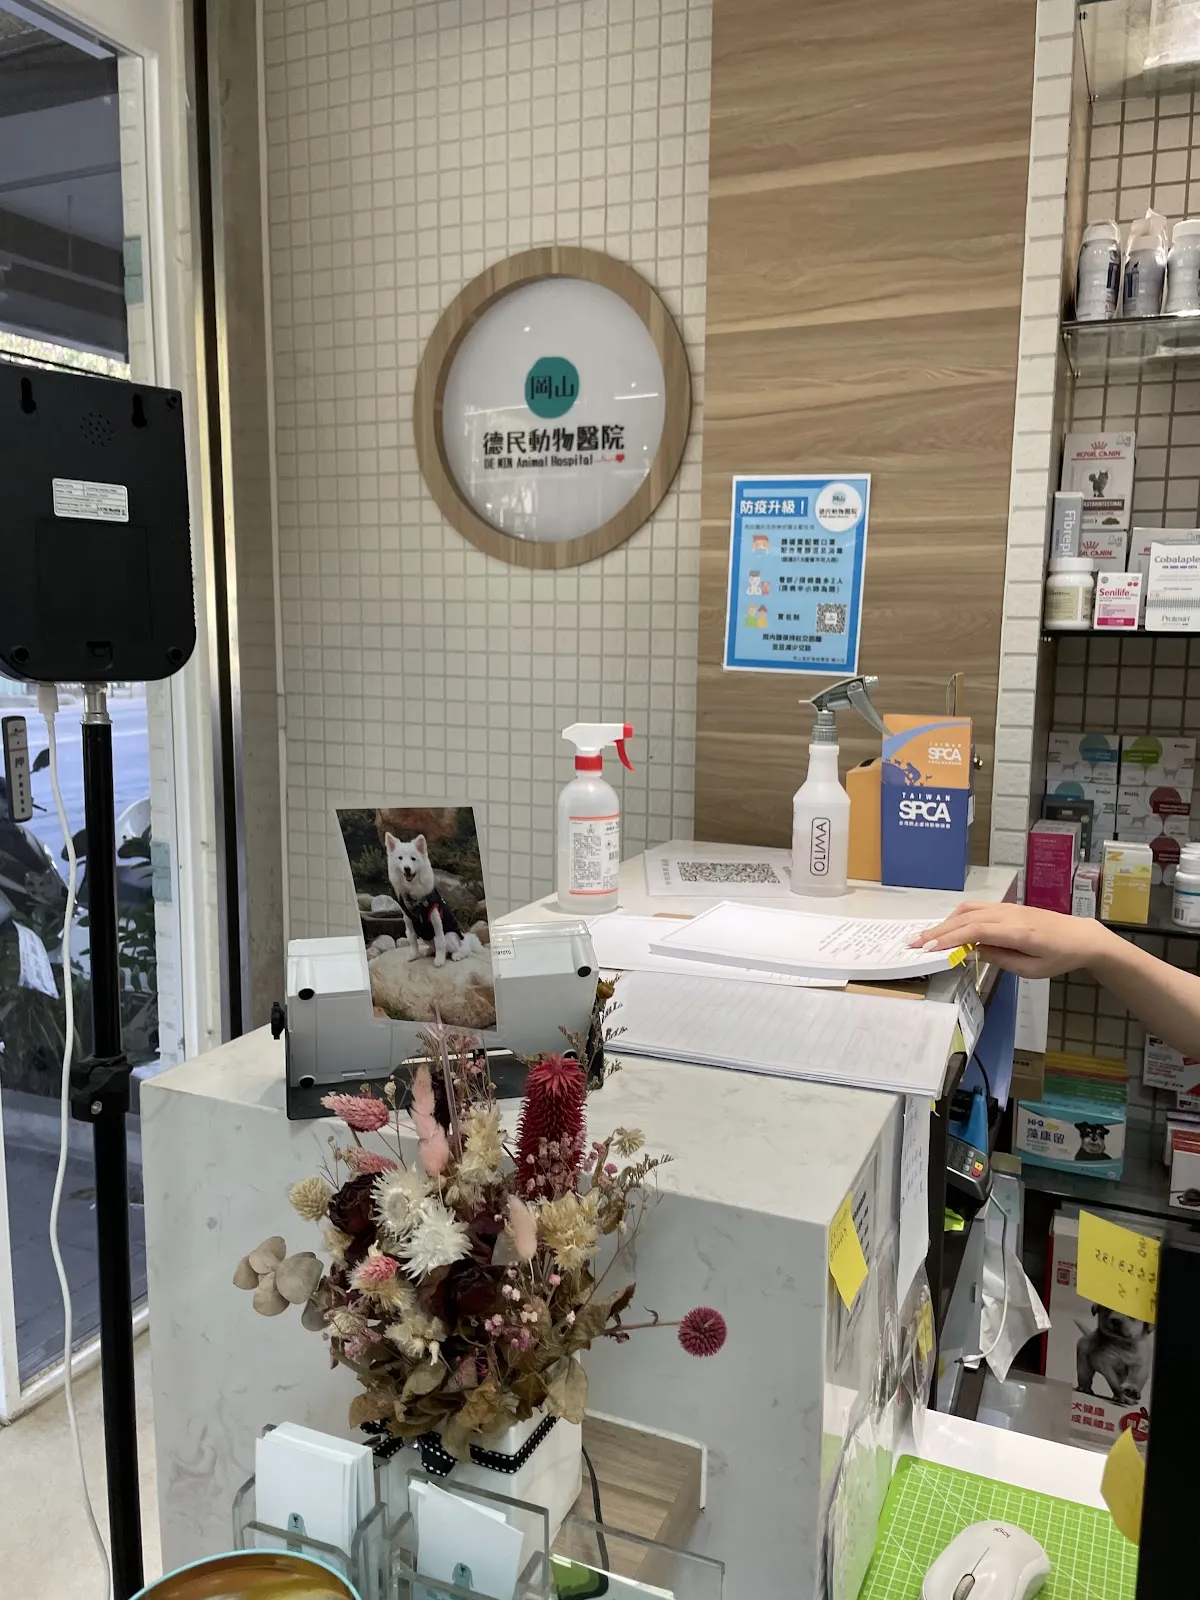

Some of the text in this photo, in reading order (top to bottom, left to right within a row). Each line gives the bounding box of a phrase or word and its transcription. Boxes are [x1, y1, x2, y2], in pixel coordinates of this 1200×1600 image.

[530, 375, 575, 400] 岡山
[483, 424, 625, 455] 德民動物醫院
[517, 454, 548, 468] Animal
[551, 453, 593, 468] Hospital
[1061, 510, 1077, 558] Fibrepl
[1154, 555, 1200, 564] Cobalaple
[1099, 588, 1130, 597] Senilife
[928, 747, 962, 761] SPCA
[902, 792, 950, 801] TAIWAN
[899, 800, 951, 822] SPCA
